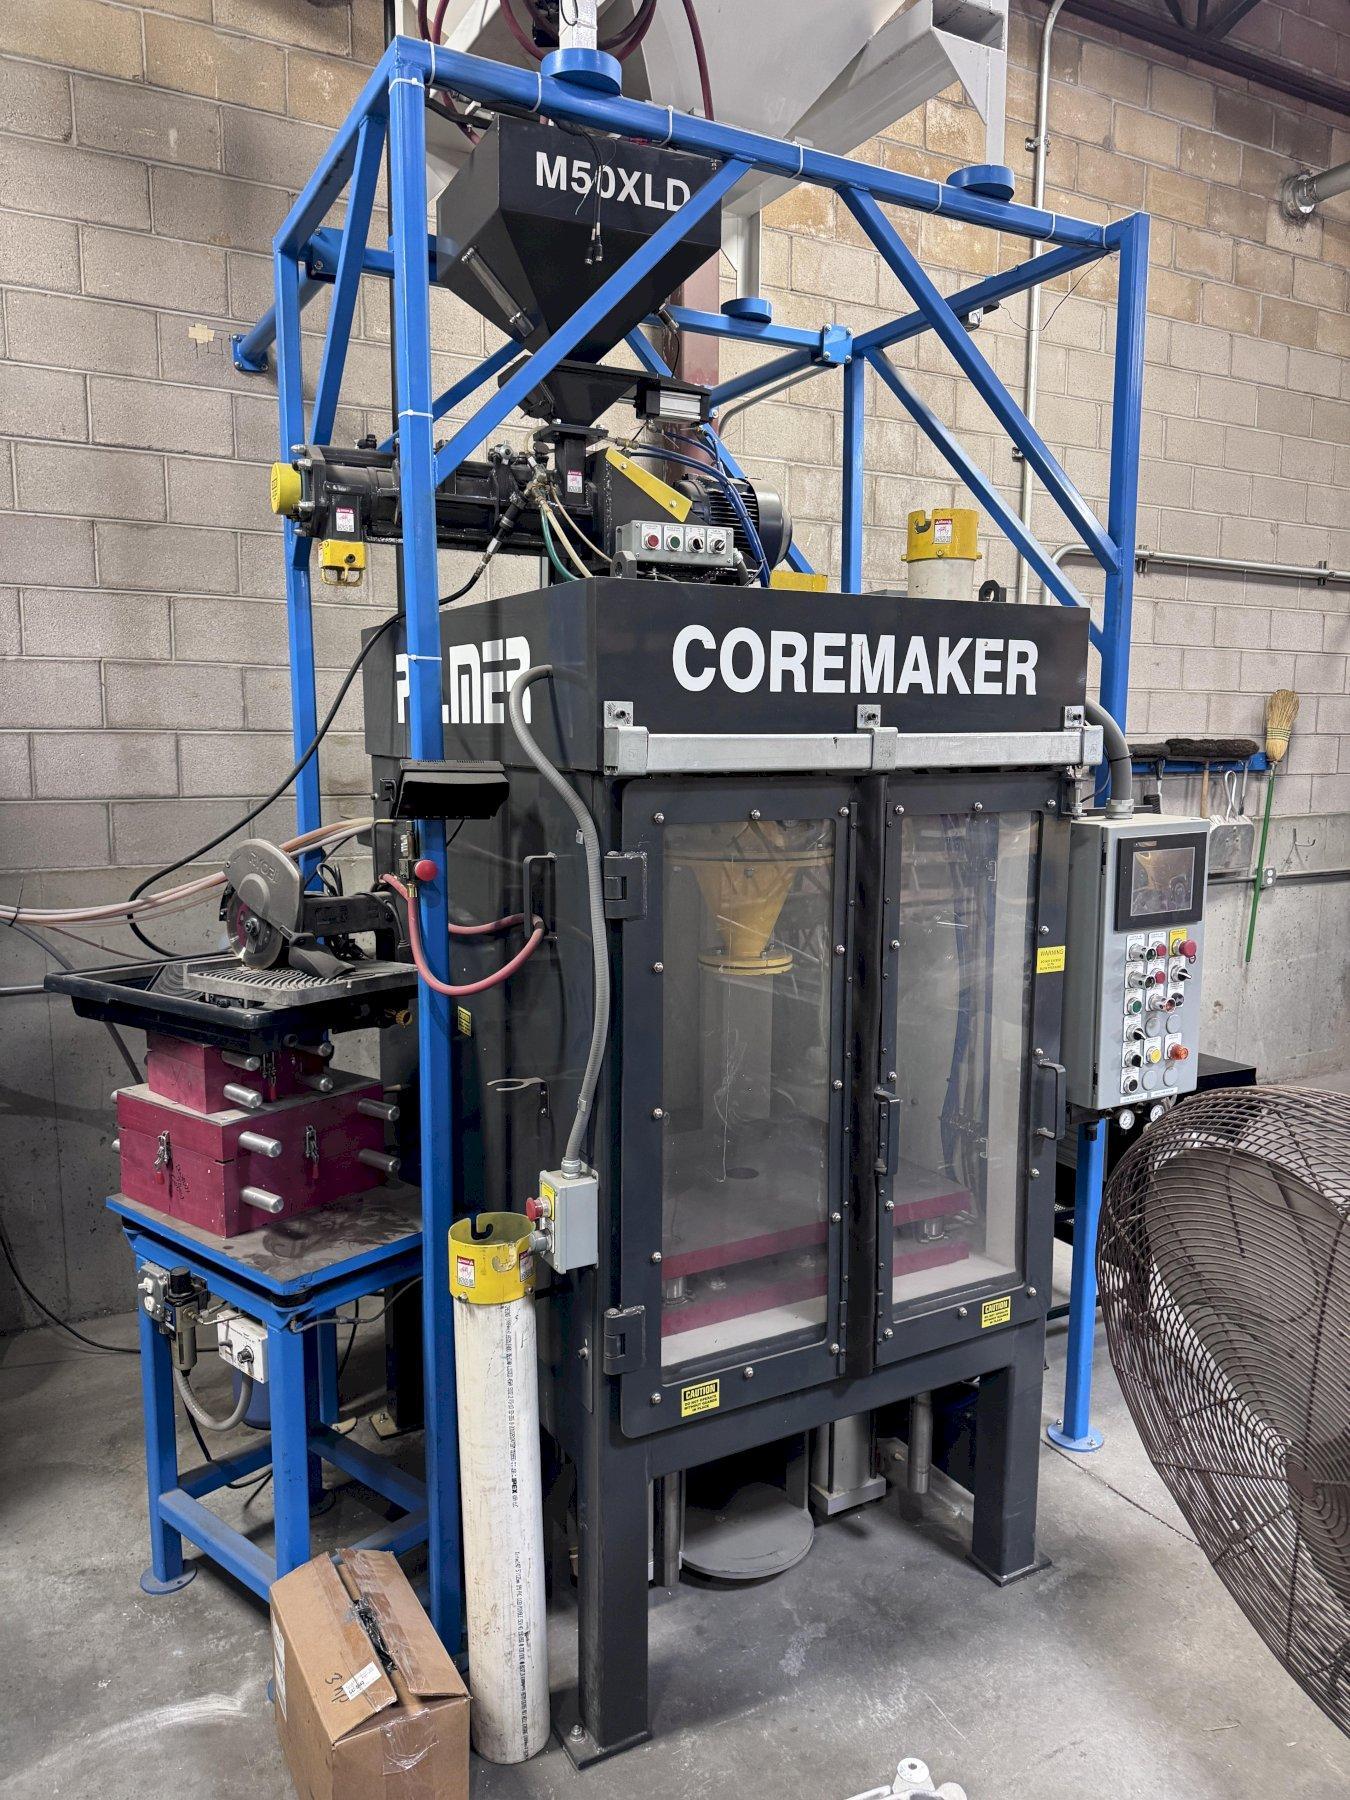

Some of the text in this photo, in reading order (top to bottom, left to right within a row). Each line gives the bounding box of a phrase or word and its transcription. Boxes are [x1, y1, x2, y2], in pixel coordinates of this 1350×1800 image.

[536, 151, 691, 212] M50XLD
[396, 636, 532, 723] PMER
[672, 624, 1039, 695] COREMAKER
[985, 1300, 1008, 1313] CAUTION
[685, 1383, 716, 1400] CAUTION
